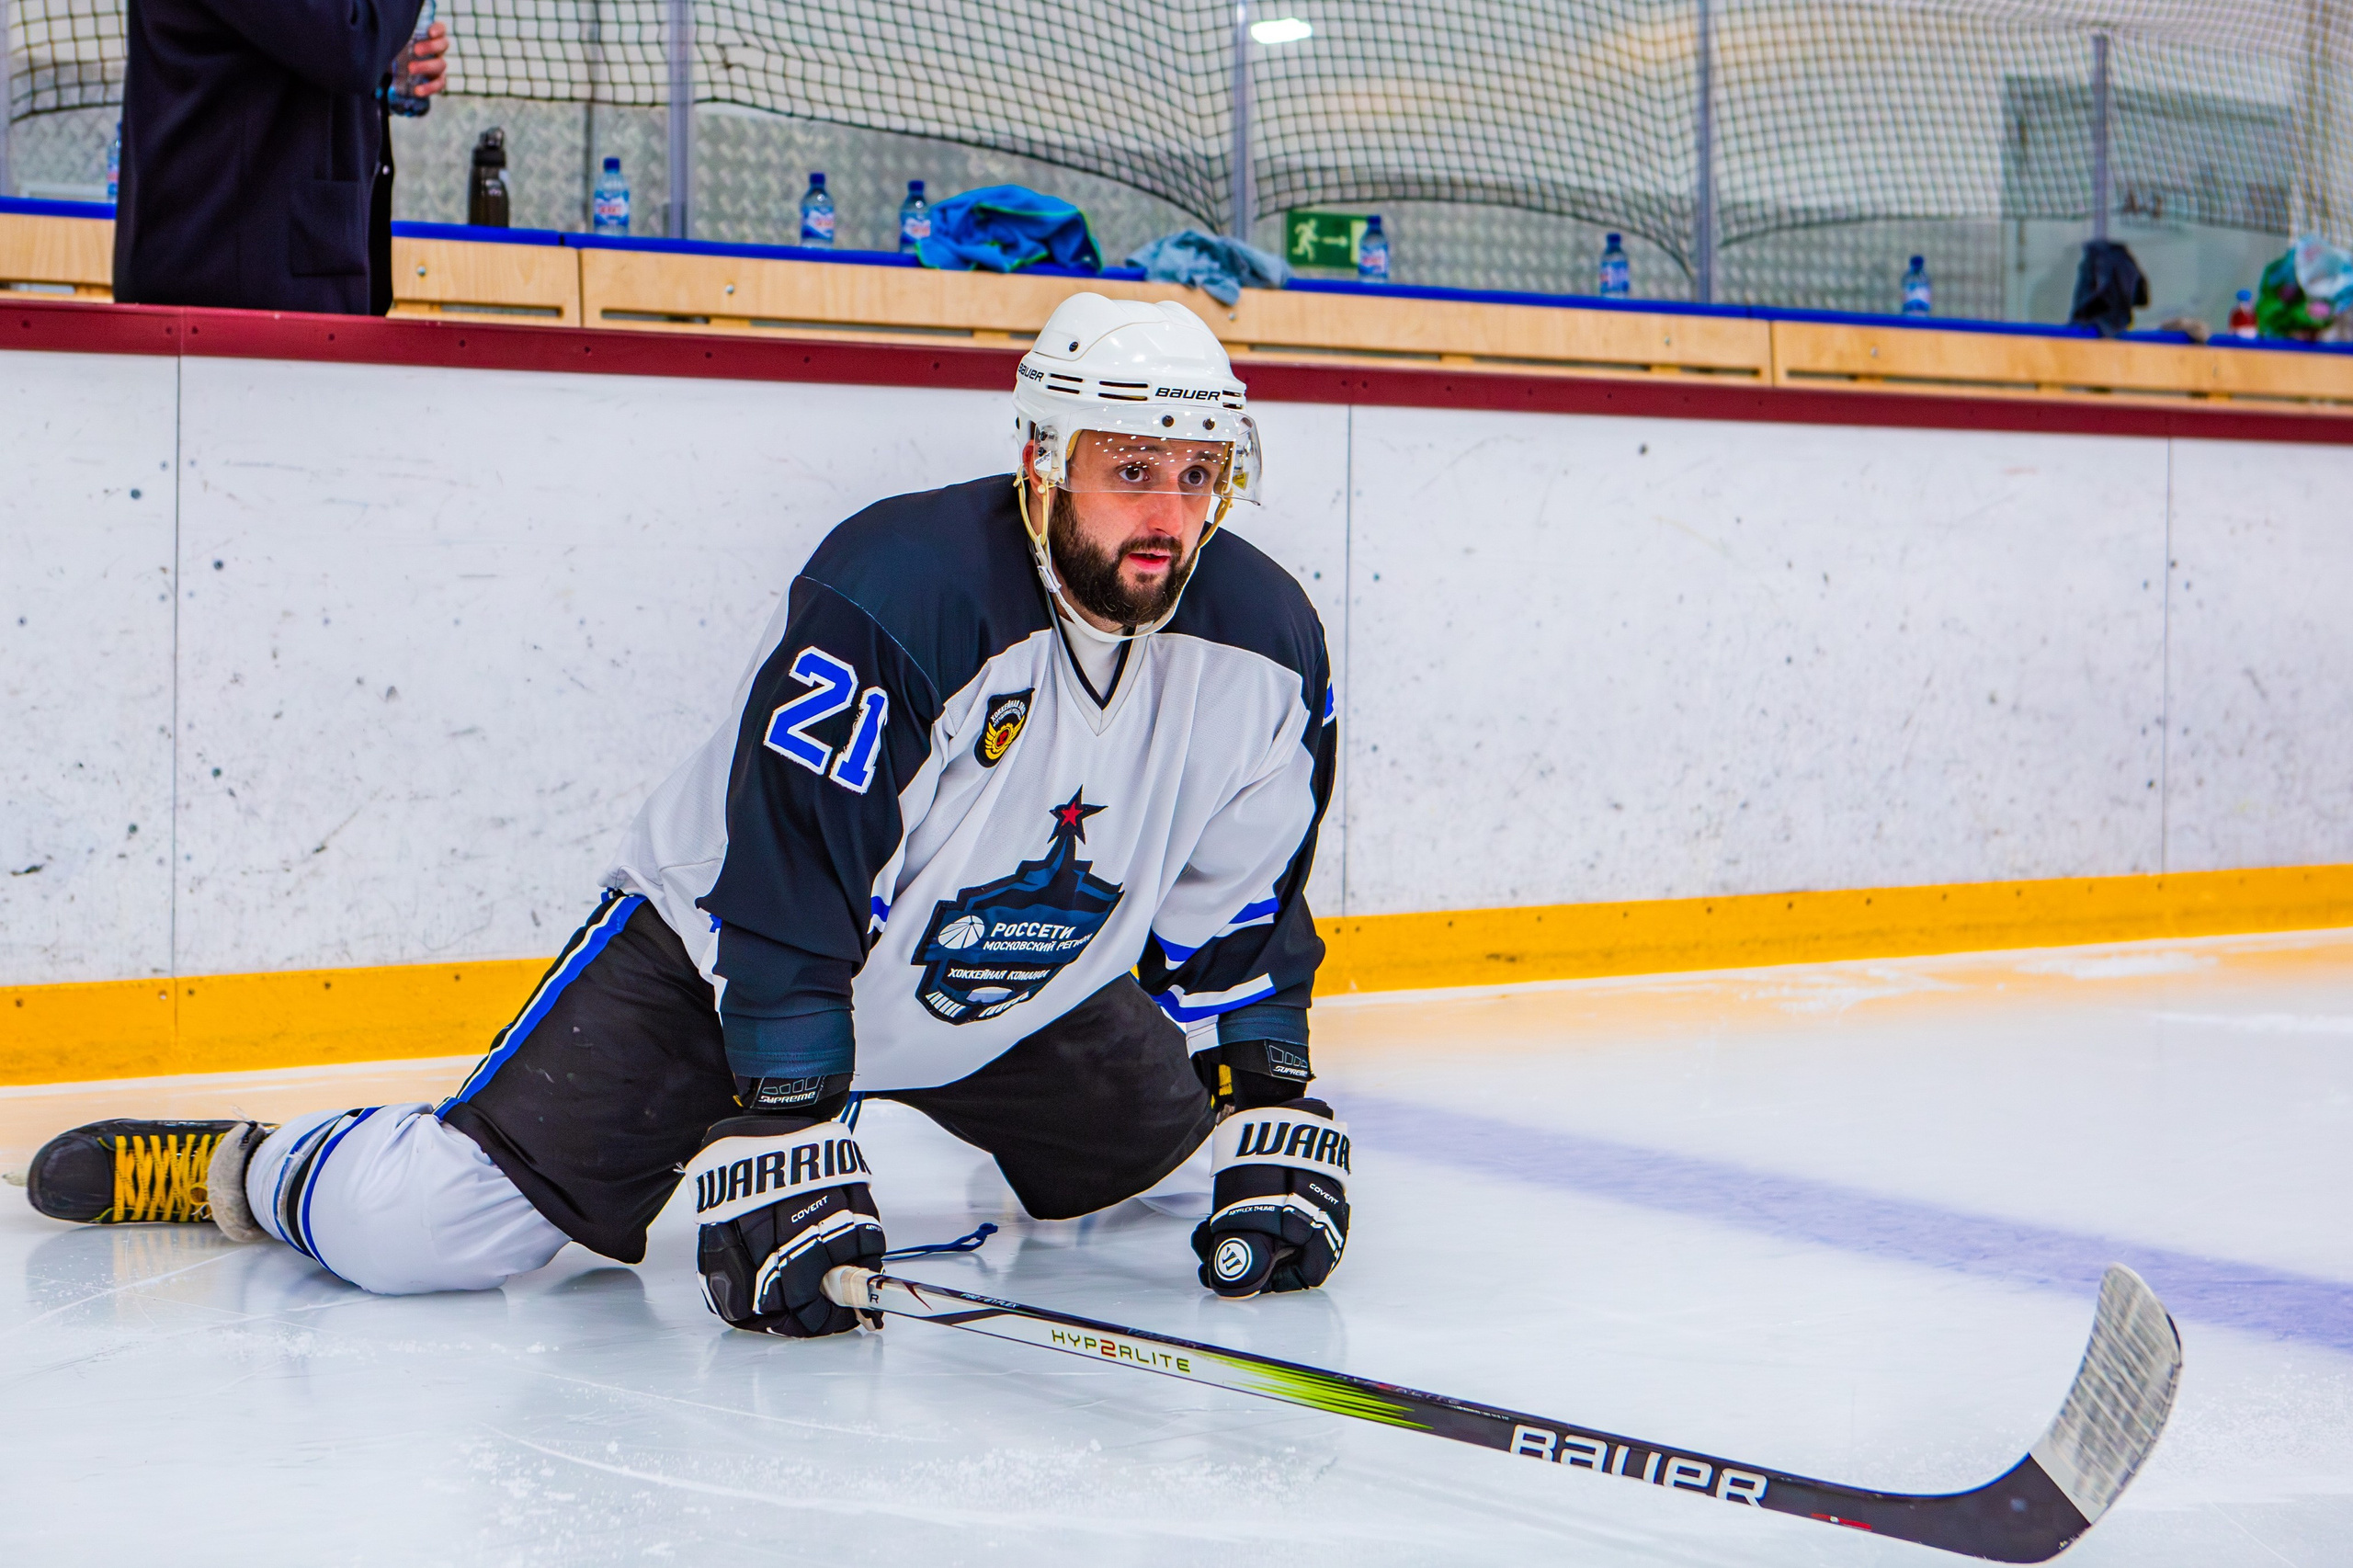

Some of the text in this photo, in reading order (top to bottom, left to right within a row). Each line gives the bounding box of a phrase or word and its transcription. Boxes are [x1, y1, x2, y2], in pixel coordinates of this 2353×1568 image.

[764, 646, 889, 794] 21
[990, 922, 1077, 939] РОССЕТИ
[983, 940, 1057, 952] МОСКОВСКИЙ
[948, 968, 1007, 980] ХОККЕЙНАЯ
[1309, 1183, 1339, 1205] COVERT
[790, 1195, 828, 1223] COVERT
[1051, 1329, 1191, 1373] HYP2RLITE
